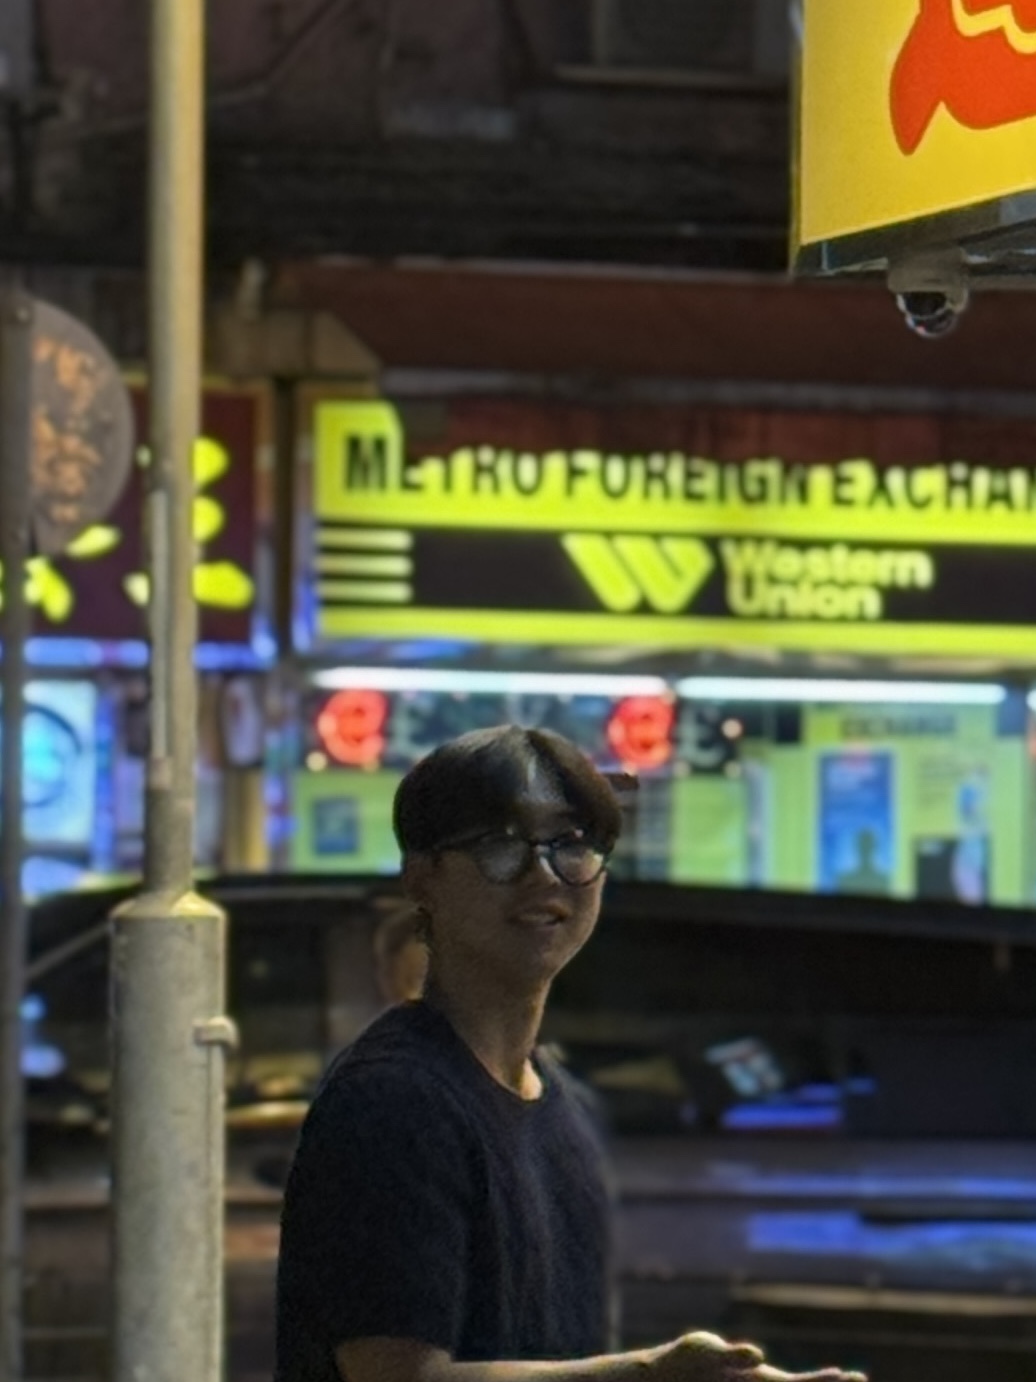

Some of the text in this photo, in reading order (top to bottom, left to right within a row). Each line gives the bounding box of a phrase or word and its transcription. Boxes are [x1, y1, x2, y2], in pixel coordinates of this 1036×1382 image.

[565, 446, 806, 508] FOREIGN
[720, 538, 934, 590] Western
[726, 580, 883, 620] Union
